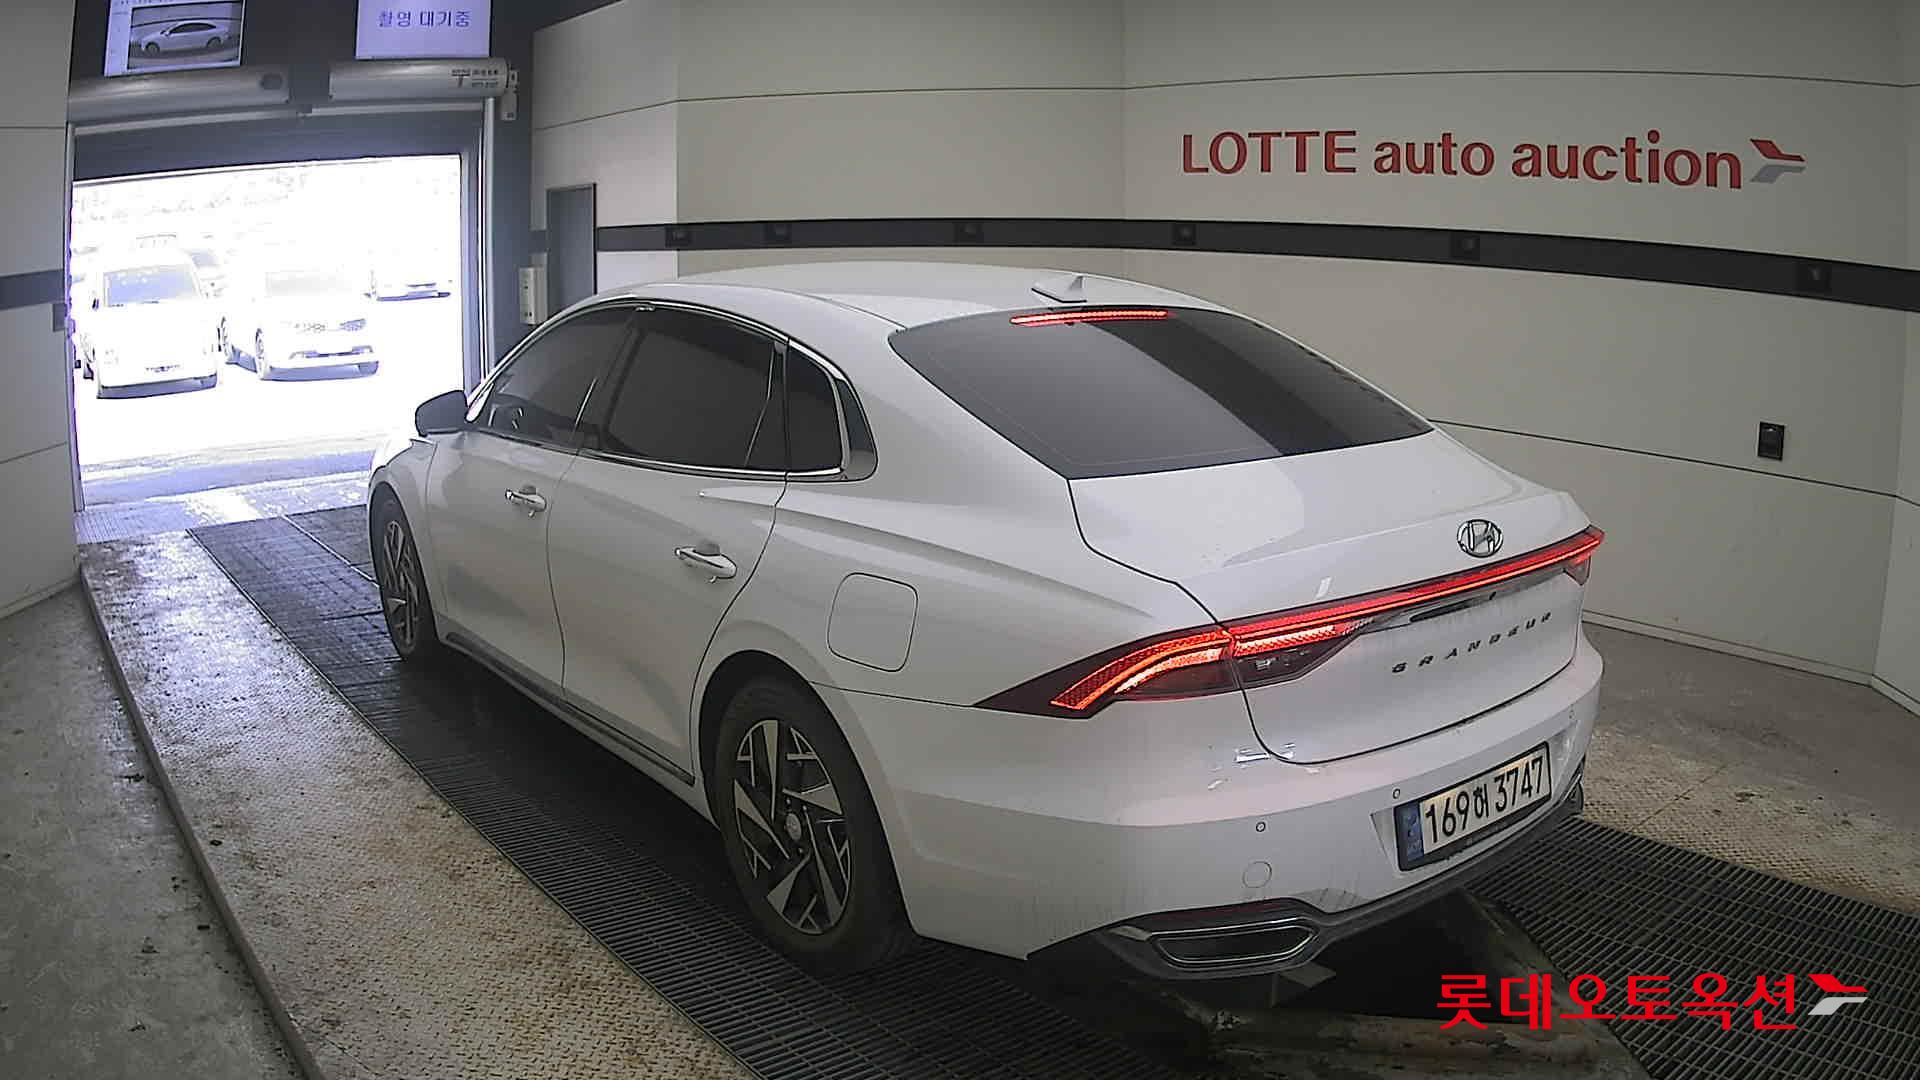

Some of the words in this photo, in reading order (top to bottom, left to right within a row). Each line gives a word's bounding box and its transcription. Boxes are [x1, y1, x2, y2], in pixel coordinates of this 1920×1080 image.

[420, 10, 470, 28] 대기중
[1182, 130, 1357, 174] LOTTE
[1374, 132, 1494, 176] auto
[1511, 129, 1742, 189] auction
[1391, 611, 1551, 673] GRANDEUR
[1424, 782, 1490, 844] 169허
[1494, 755, 1544, 813] 3747
